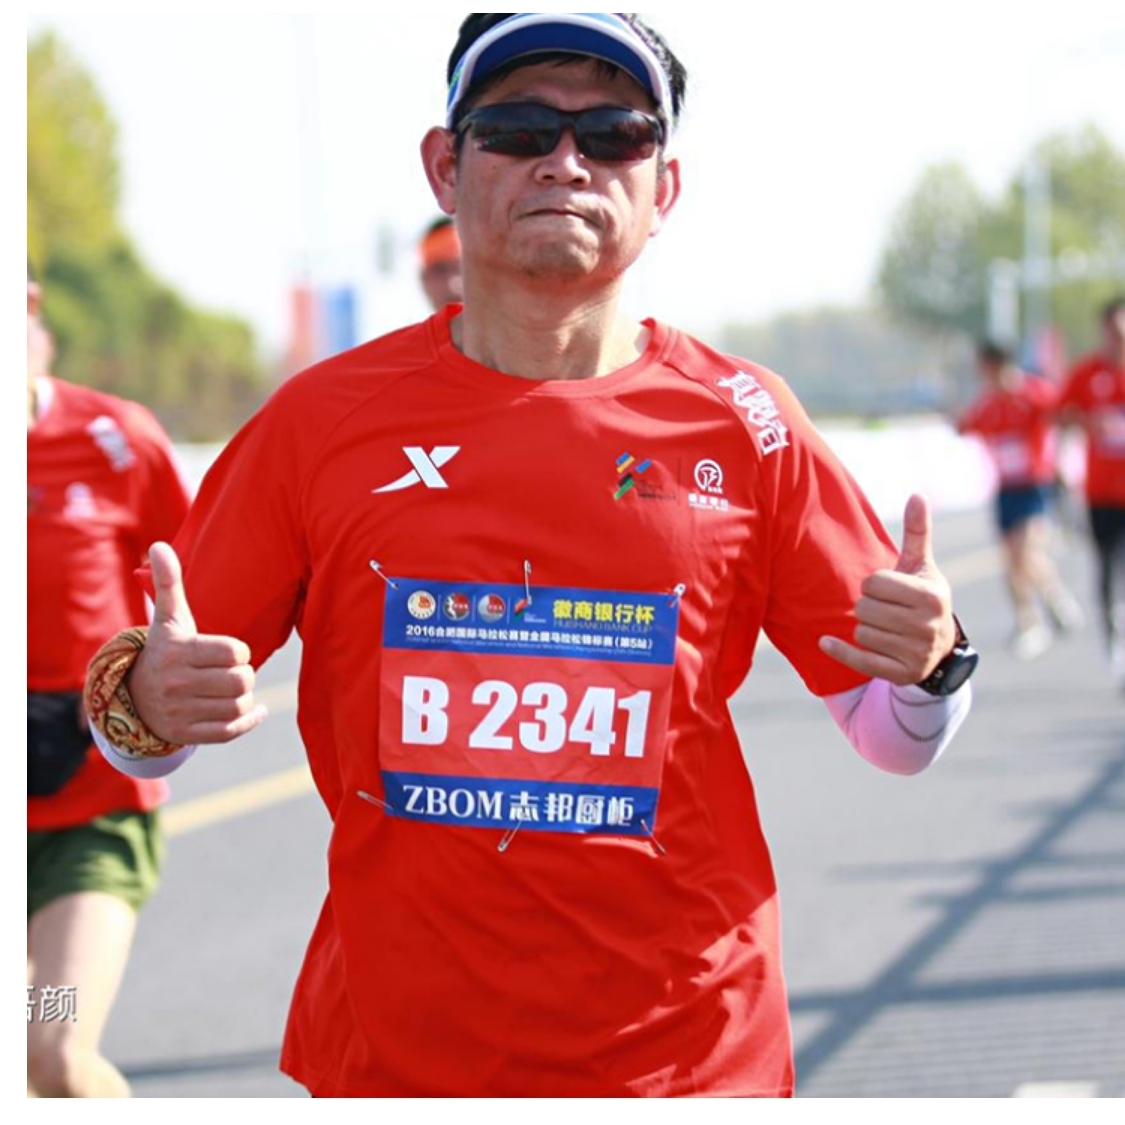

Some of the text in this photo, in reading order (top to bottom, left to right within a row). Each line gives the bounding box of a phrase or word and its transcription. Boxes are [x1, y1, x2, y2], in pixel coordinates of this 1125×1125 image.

[553, 599, 656, 625] 徽商银行杯
[401, 675, 653, 759] B 2341
[402, 784, 504, 821] ZBOM
